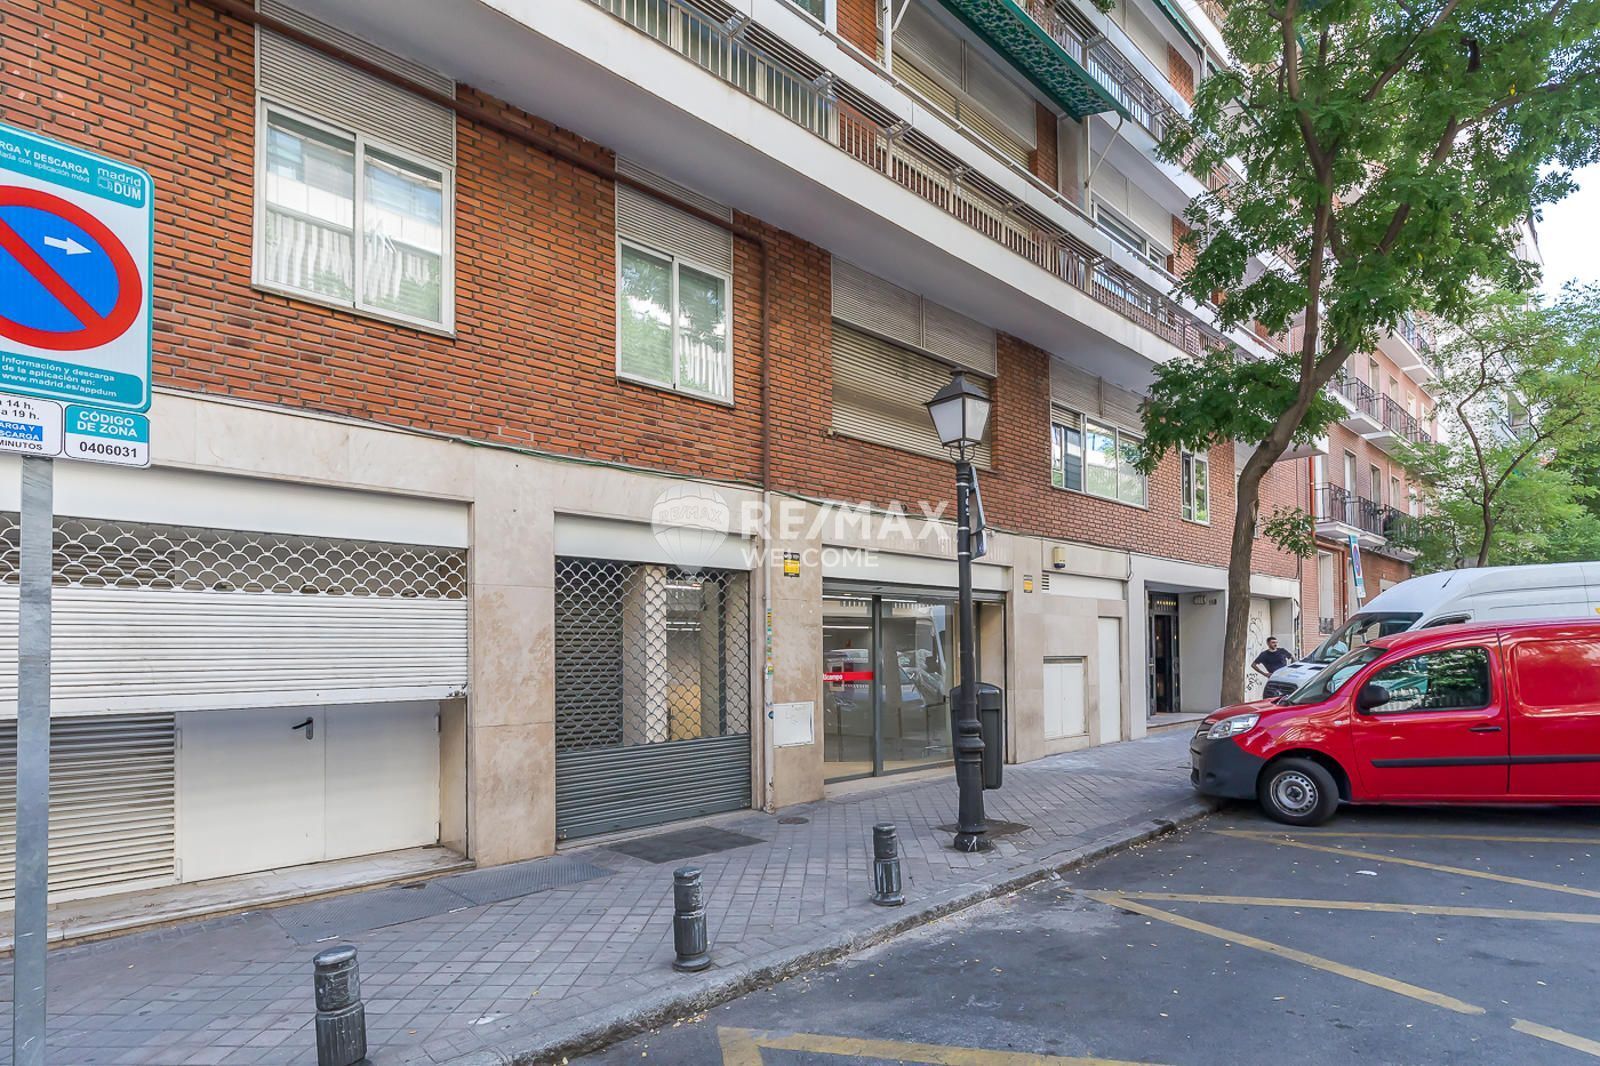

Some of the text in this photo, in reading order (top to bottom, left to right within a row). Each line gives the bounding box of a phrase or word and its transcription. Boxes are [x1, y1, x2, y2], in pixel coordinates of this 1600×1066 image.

[17, 156, 32, 165] con
[33, 162, 70, 178] aplicación
[24, 148, 32, 157] Y
[33, 151, 90, 177] DESCARGA
[98, 167, 141, 187] madrid
[114, 182, 141, 201] DUM
[2, 355, 62, 373] Información
[72, 368, 115, 382] descarga
[2, 364, 96, 386] de la aplicación en:
[2, 373, 117, 397] www.madrid.es/appdum
[7, 400, 20, 409] 14
[24, 402, 34, 411] h.
[12, 409, 25, 419] 19
[29, 412, 40, 421] h.
[79, 411, 135, 427] CÓDIGO
[28, 425, 35, 433] Y
[76, 422, 138, 438] DE ZONA
[79, 441, 137, 458] 0406031
